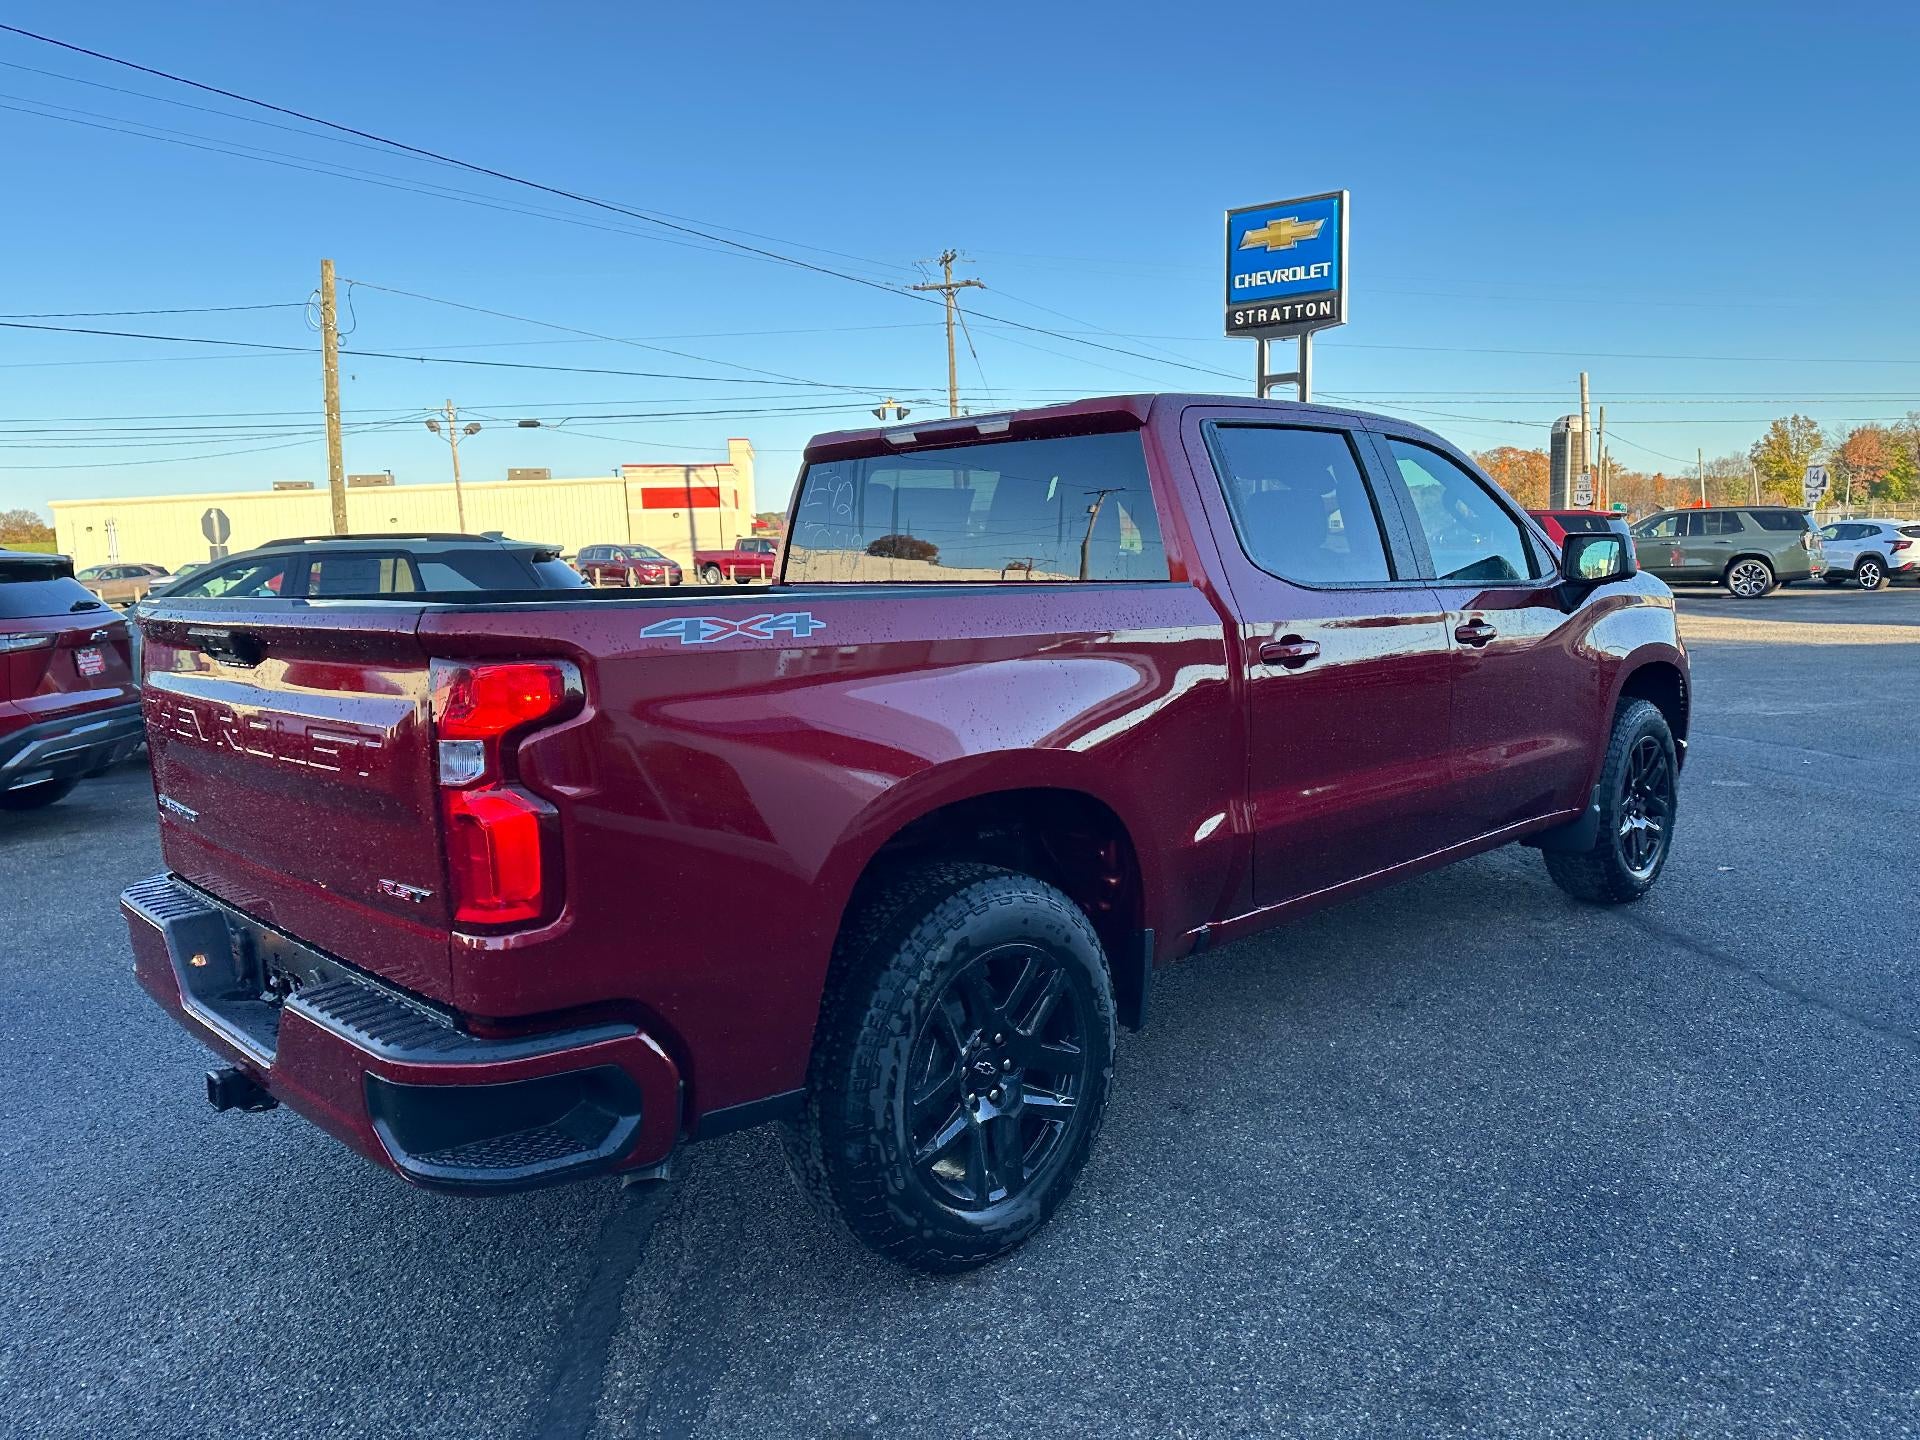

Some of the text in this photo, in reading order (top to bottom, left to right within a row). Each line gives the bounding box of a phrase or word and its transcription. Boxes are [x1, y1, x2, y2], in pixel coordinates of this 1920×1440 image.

[1234, 261, 1331, 289] CHEVROLET
[1234, 301, 1331, 325] STRATTON
[1809, 469, 1820, 482] 14
[1576, 493, 1591, 501] 165
[377, 879, 433, 903] RST
